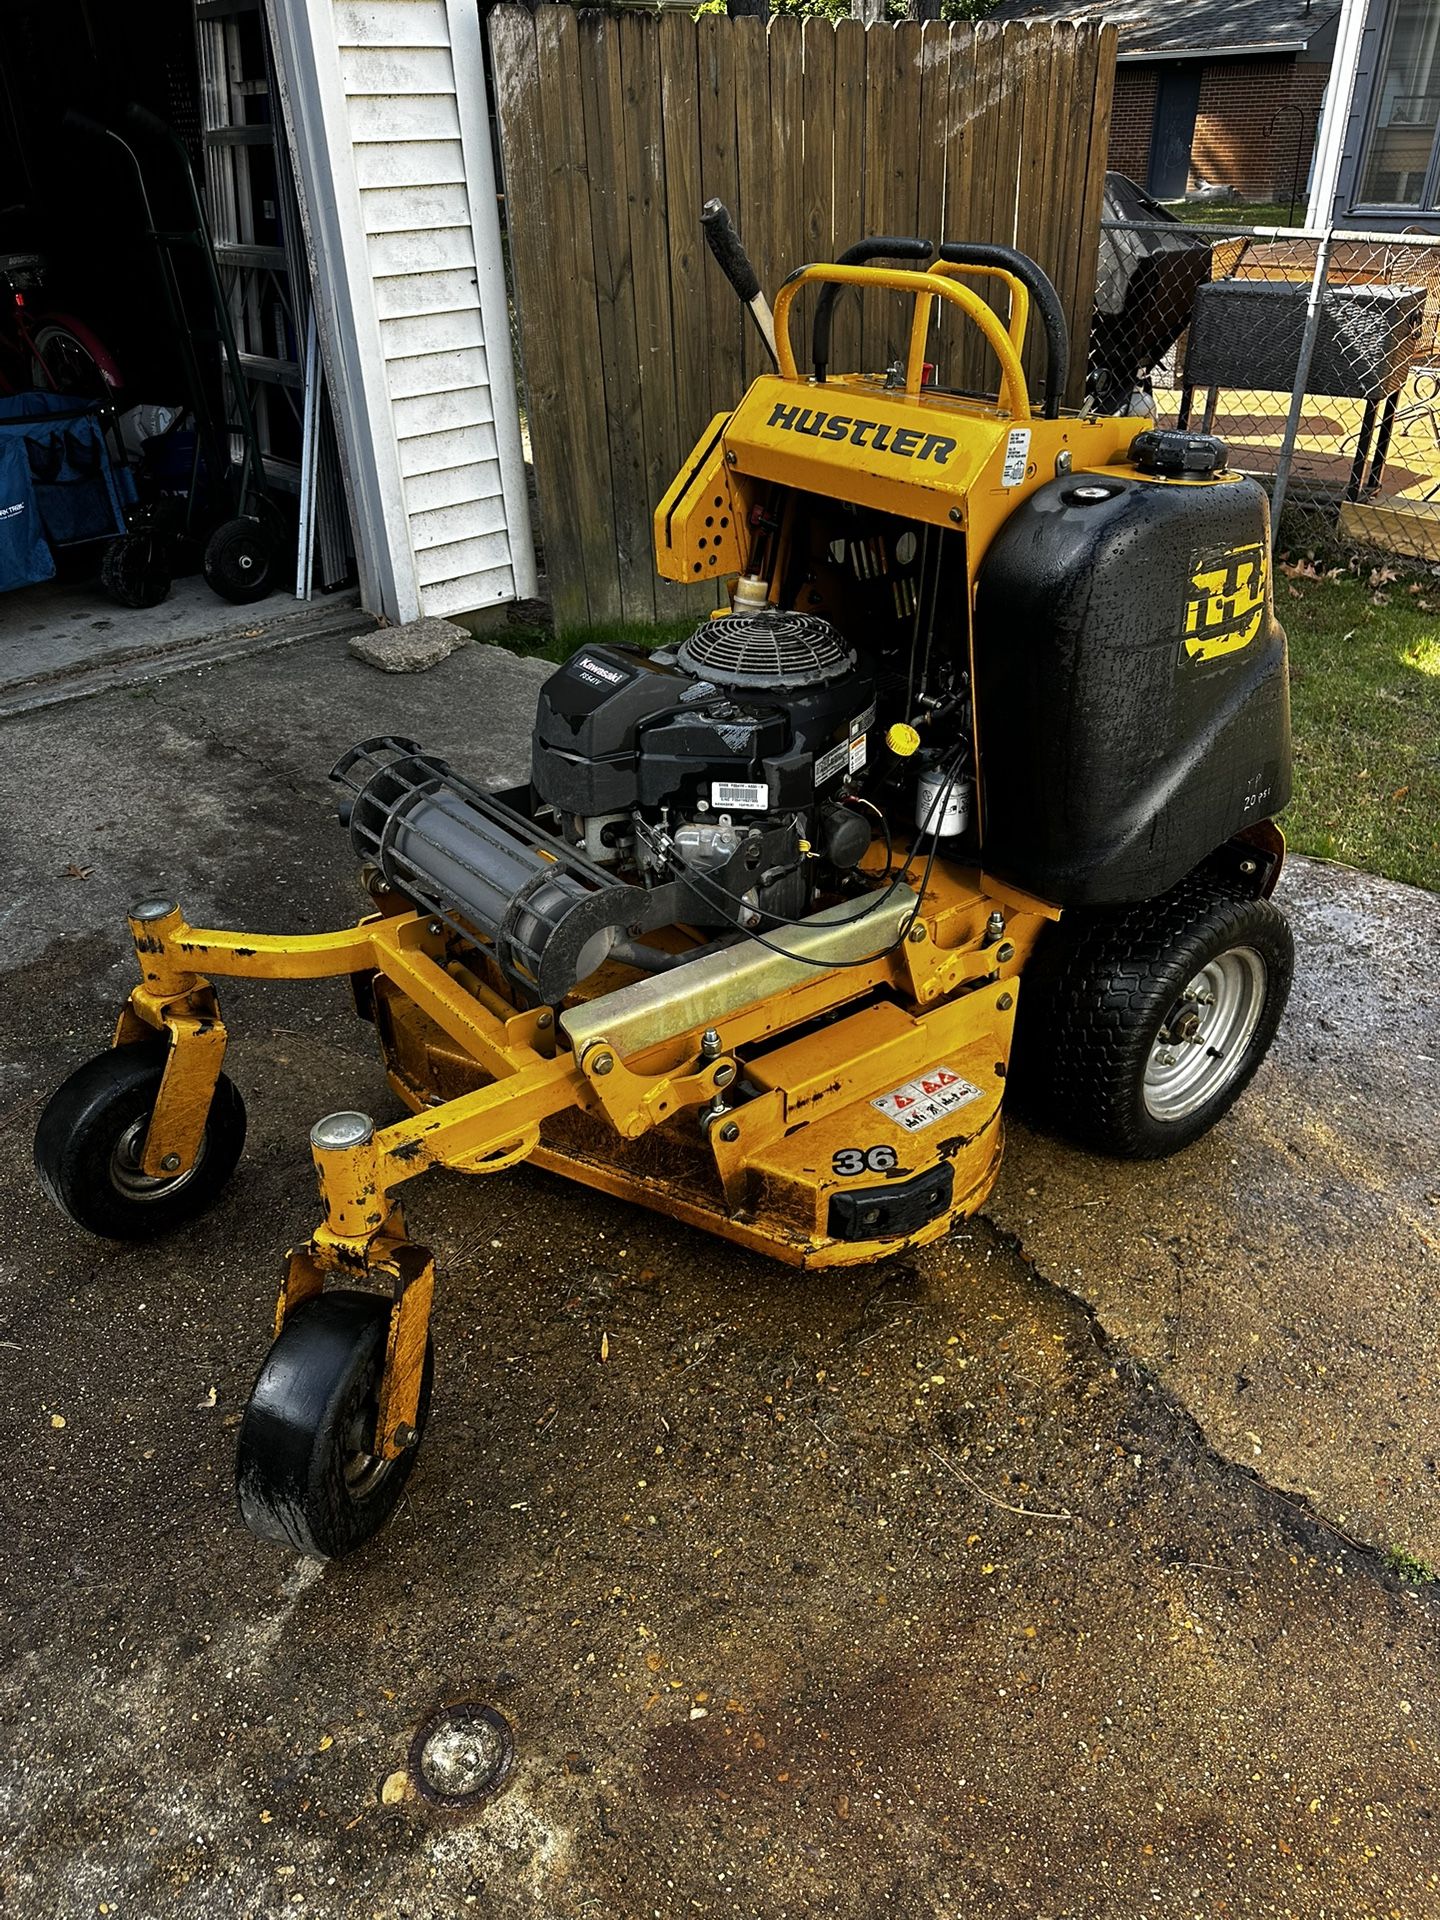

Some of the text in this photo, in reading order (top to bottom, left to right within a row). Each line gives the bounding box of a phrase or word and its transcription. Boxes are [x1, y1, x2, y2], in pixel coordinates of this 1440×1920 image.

[767, 403, 957, 464] HUSTLER
[580, 658, 622, 683] Kawasaki
[832, 1146, 898, 1176] 36
